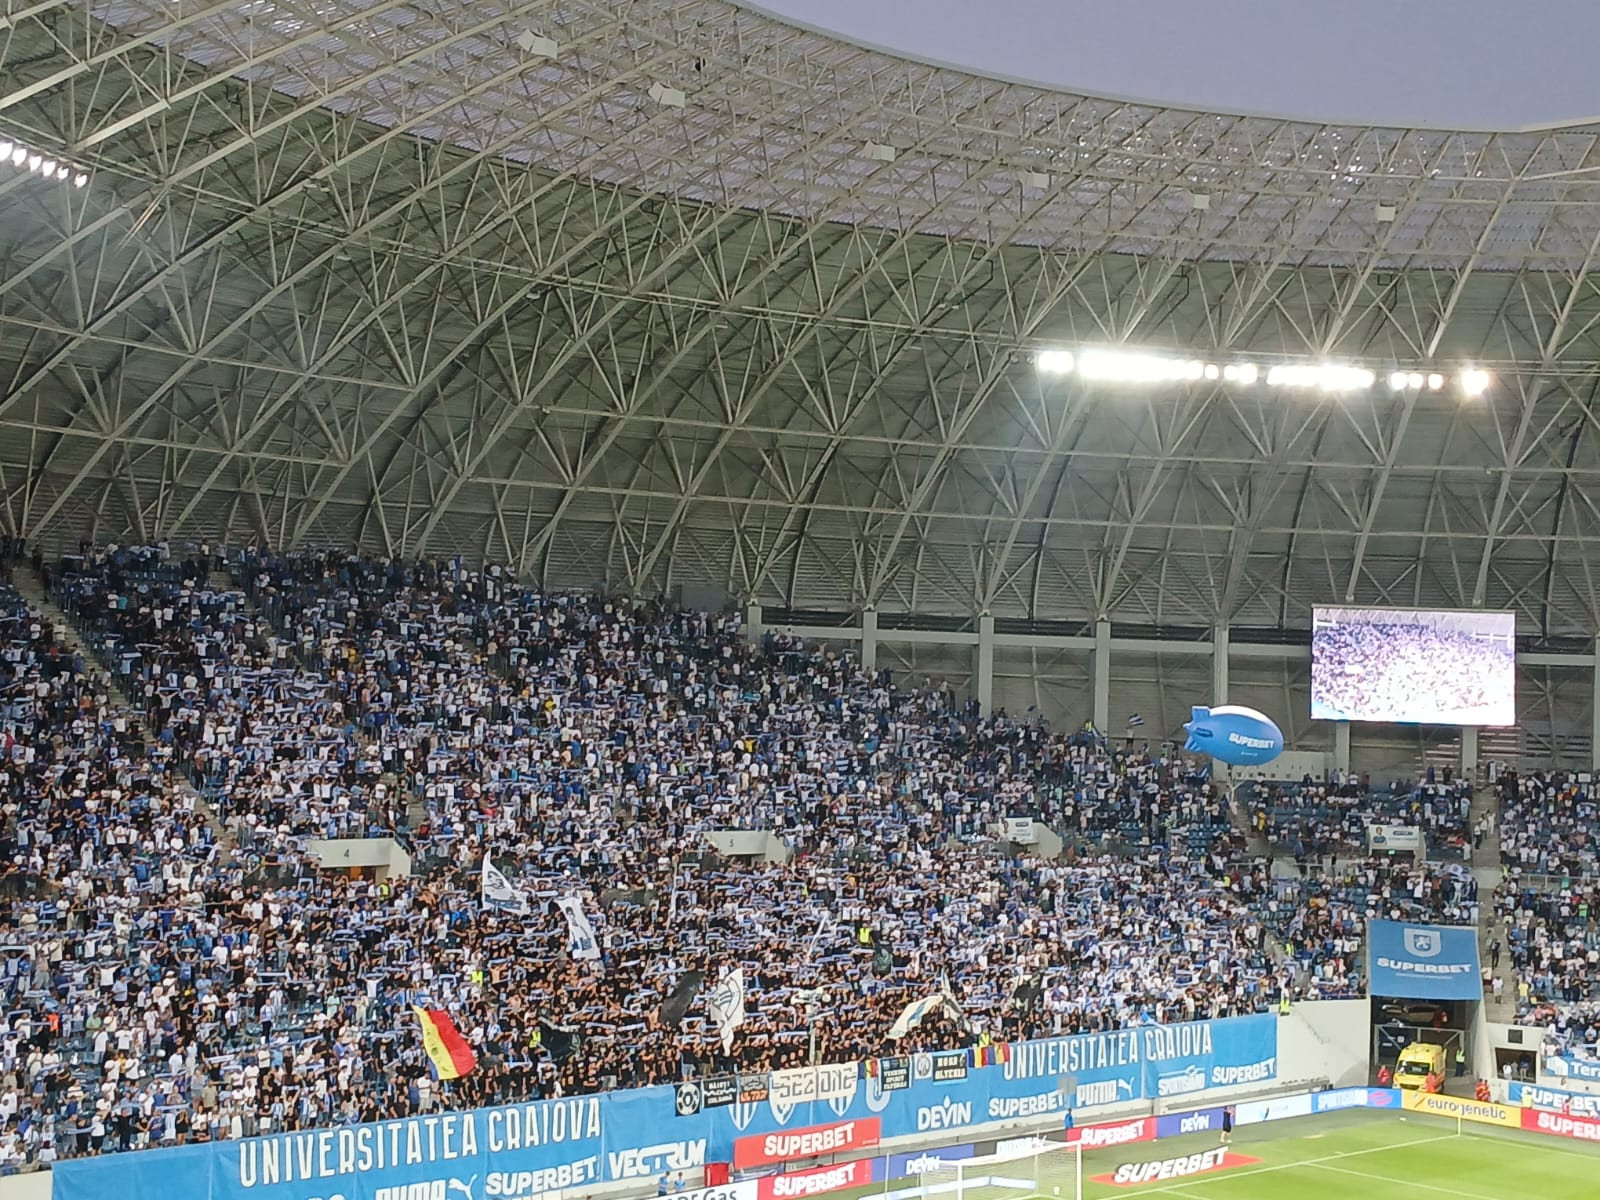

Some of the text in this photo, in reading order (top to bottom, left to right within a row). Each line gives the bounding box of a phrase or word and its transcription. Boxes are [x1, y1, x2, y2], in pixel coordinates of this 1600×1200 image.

[1228, 732, 1275, 749] SUPERBET
[1376, 957, 1472, 974] SUPERBET
[1003, 1023, 1212, 1081] UNIVERSITATEA CRAIOVA
[1211, 1057, 1276, 1084] SUPERBET
[917, 1100, 972, 1131] DEVIN
[988, 1088, 1065, 1118] SUPERBET
[1080, 1120, 1145, 1145] SUPERBET
[1180, 1114, 1210, 1133] DEVIN
[1537, 1112, 1600, 1139] SUPER
[240, 1097, 600, 1187] UNIVERSITATEA CRAIOVA
[763, 1122, 855, 1156] SUPERBET
[608, 1139, 706, 1180] VECTRUM
[906, 1154, 941, 1175] DEVIN
[1114, 1145, 1229, 1184] SUPERBET
[485, 1156, 597, 1195] SUPERBET
[773, 1162, 857, 1196] SUPERBET
